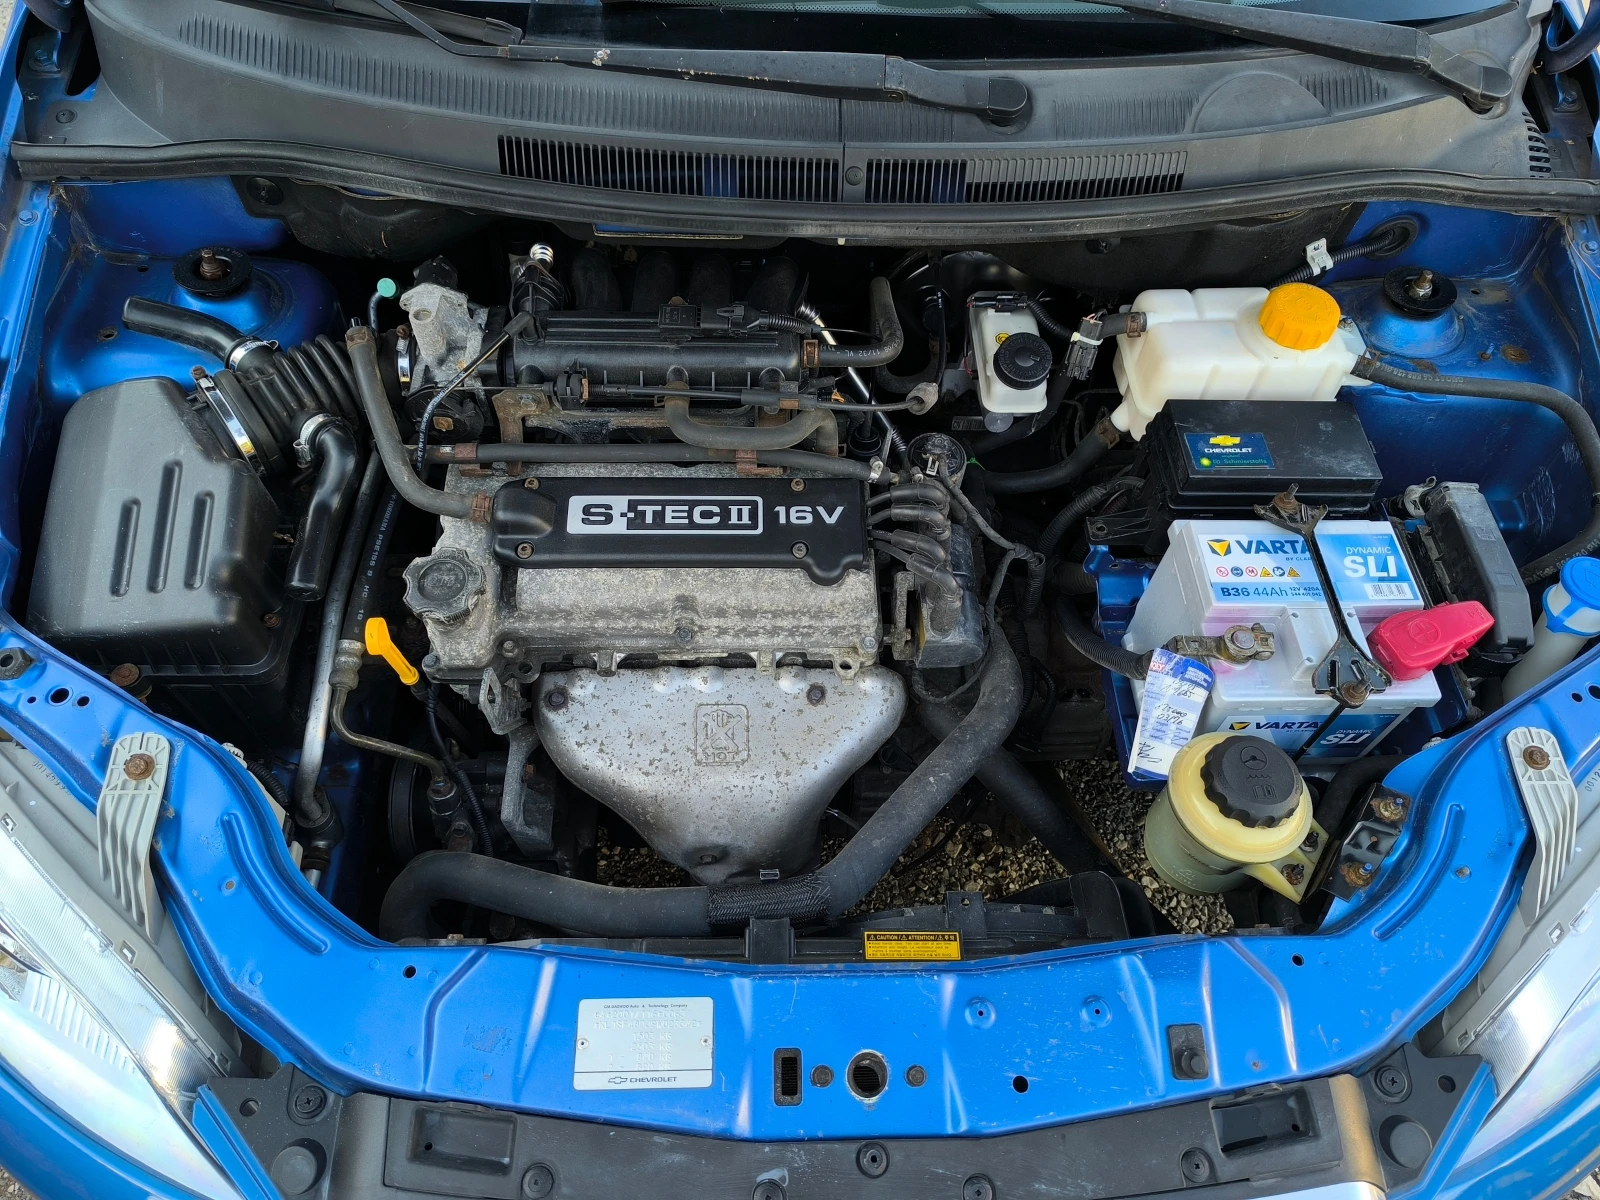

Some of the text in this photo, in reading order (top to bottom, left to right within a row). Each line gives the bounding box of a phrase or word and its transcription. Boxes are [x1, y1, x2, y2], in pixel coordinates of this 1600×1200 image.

[773, 505, 845, 524] 16V
[1345, 546, 1392, 554] DYNAMIC
[1343, 555, 1398, 578] SLI
[361, 585, 370, 598] HC
[1220, 587, 1250, 597] B36
[1253, 586, 1288, 597] 44Ah
[1255, 721, 1319, 729] VARTA
[1320, 733, 1371, 745] SLI
[1584, 768, 1600, 792] 0012
